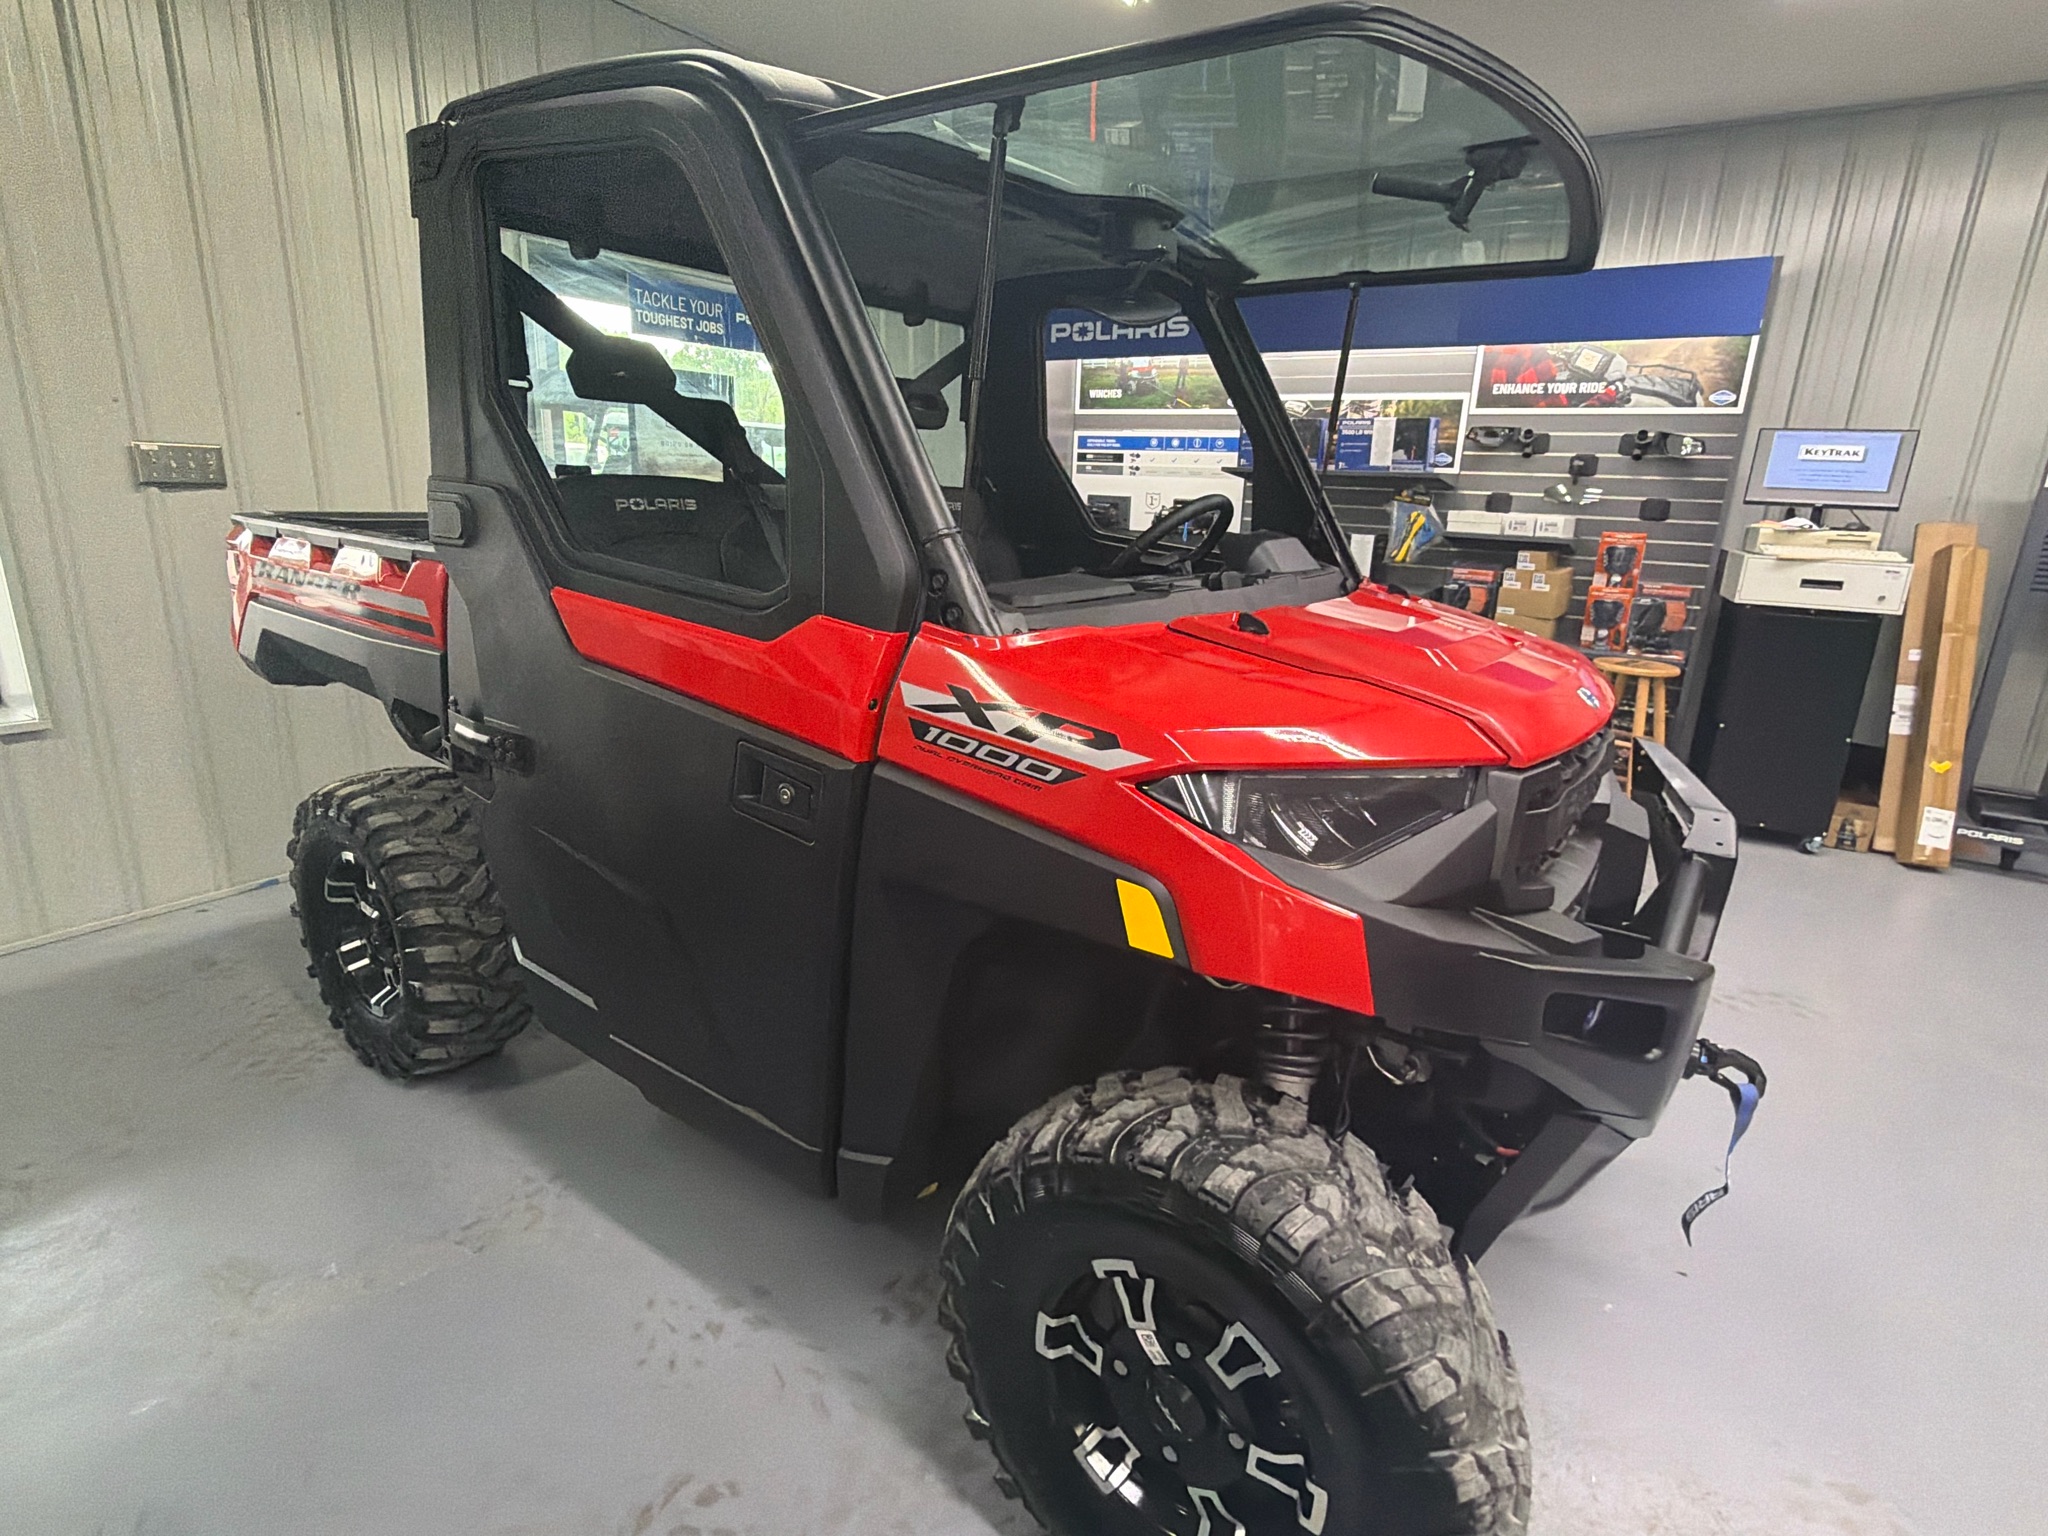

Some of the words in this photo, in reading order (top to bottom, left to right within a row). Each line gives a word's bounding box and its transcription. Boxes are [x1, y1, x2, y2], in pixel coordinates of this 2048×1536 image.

[635, 288, 687, 312] TACKLE
[689, 299, 723, 318] YOUR
[635, 309, 694, 330] TOUGHEST
[695, 321, 725, 335] JOBS
[1050, 316, 1191, 343] POLARIS
[1089, 389, 1123, 399] WINCHES
[1492, 382, 1544, 395] ENHANCE
[1547, 382, 1577, 394] YOUR
[1579, 381, 1606, 393] RIDE
[615, 498, 698, 512] POLARIS
[922, 726, 1063, 782] 1000
[1956, 828, 2025, 846] POLARIS
